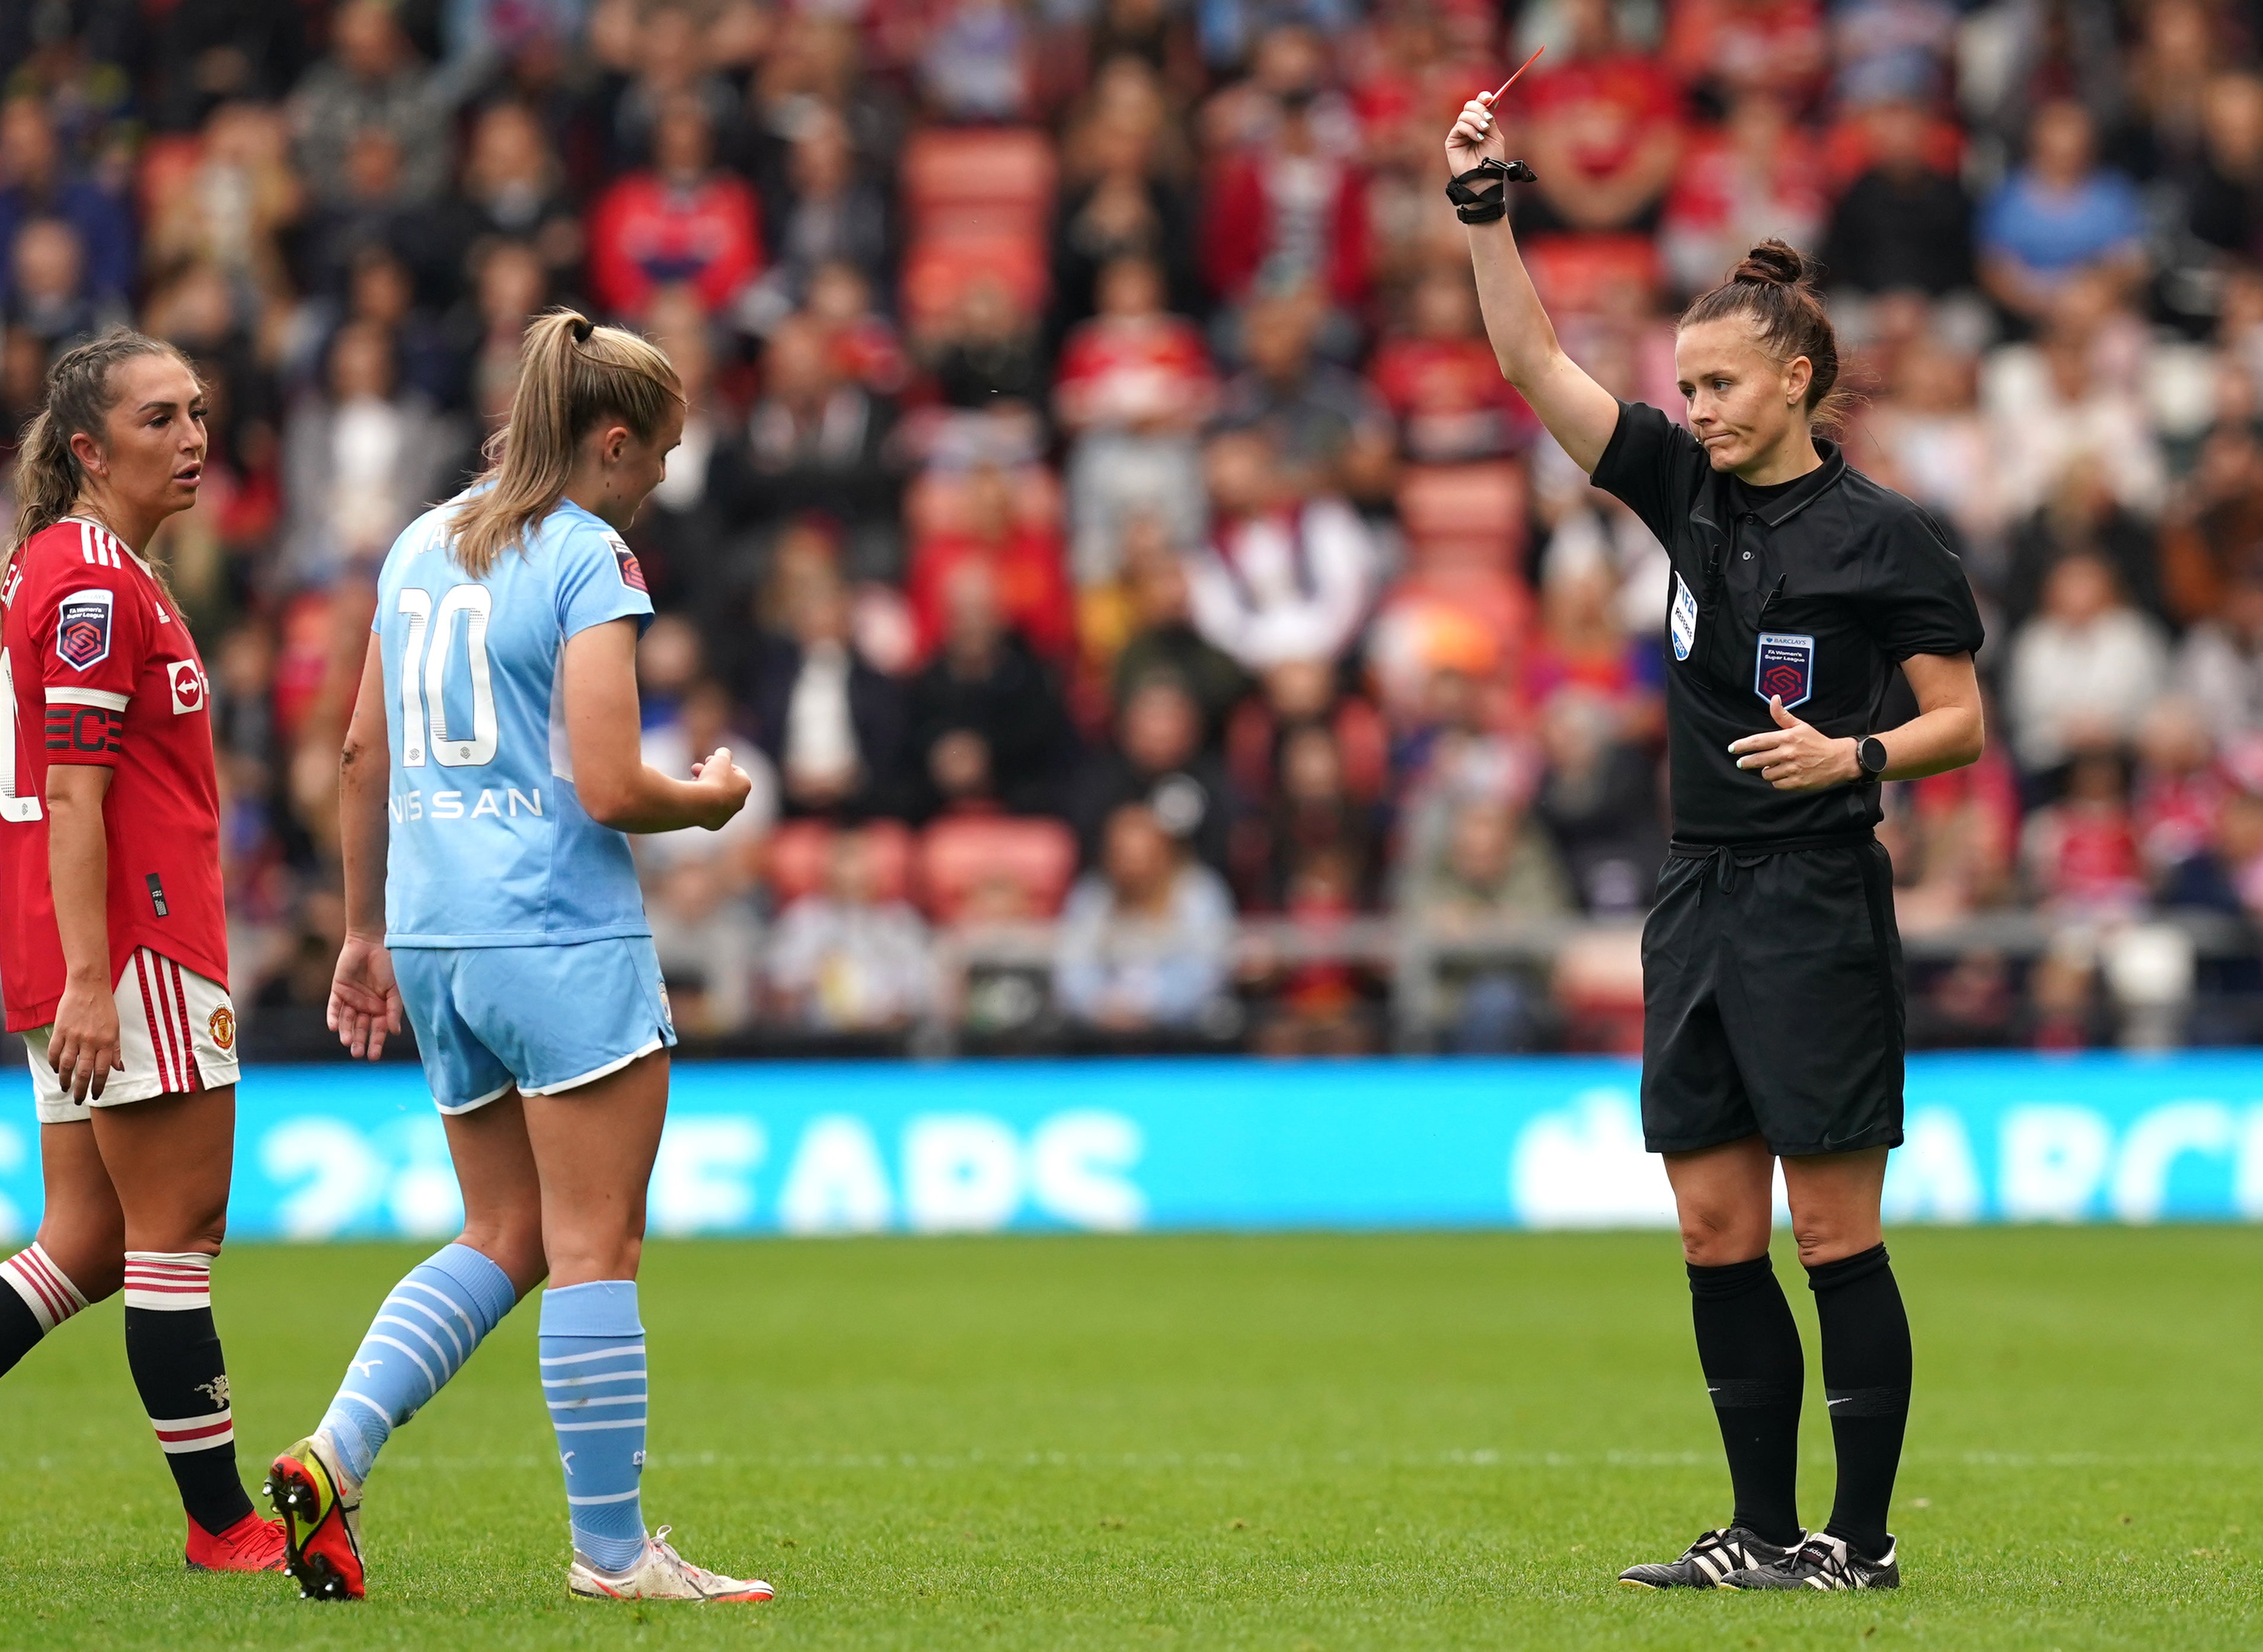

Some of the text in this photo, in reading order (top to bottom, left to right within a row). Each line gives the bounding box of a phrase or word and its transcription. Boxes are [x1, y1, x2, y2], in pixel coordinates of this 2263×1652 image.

[1678, 580, 1694, 619] FIFA
[1675, 606, 1693, 641] REFEREE
[398, 584, 499, 767] 10
[388, 788, 543, 824] NISSAN
